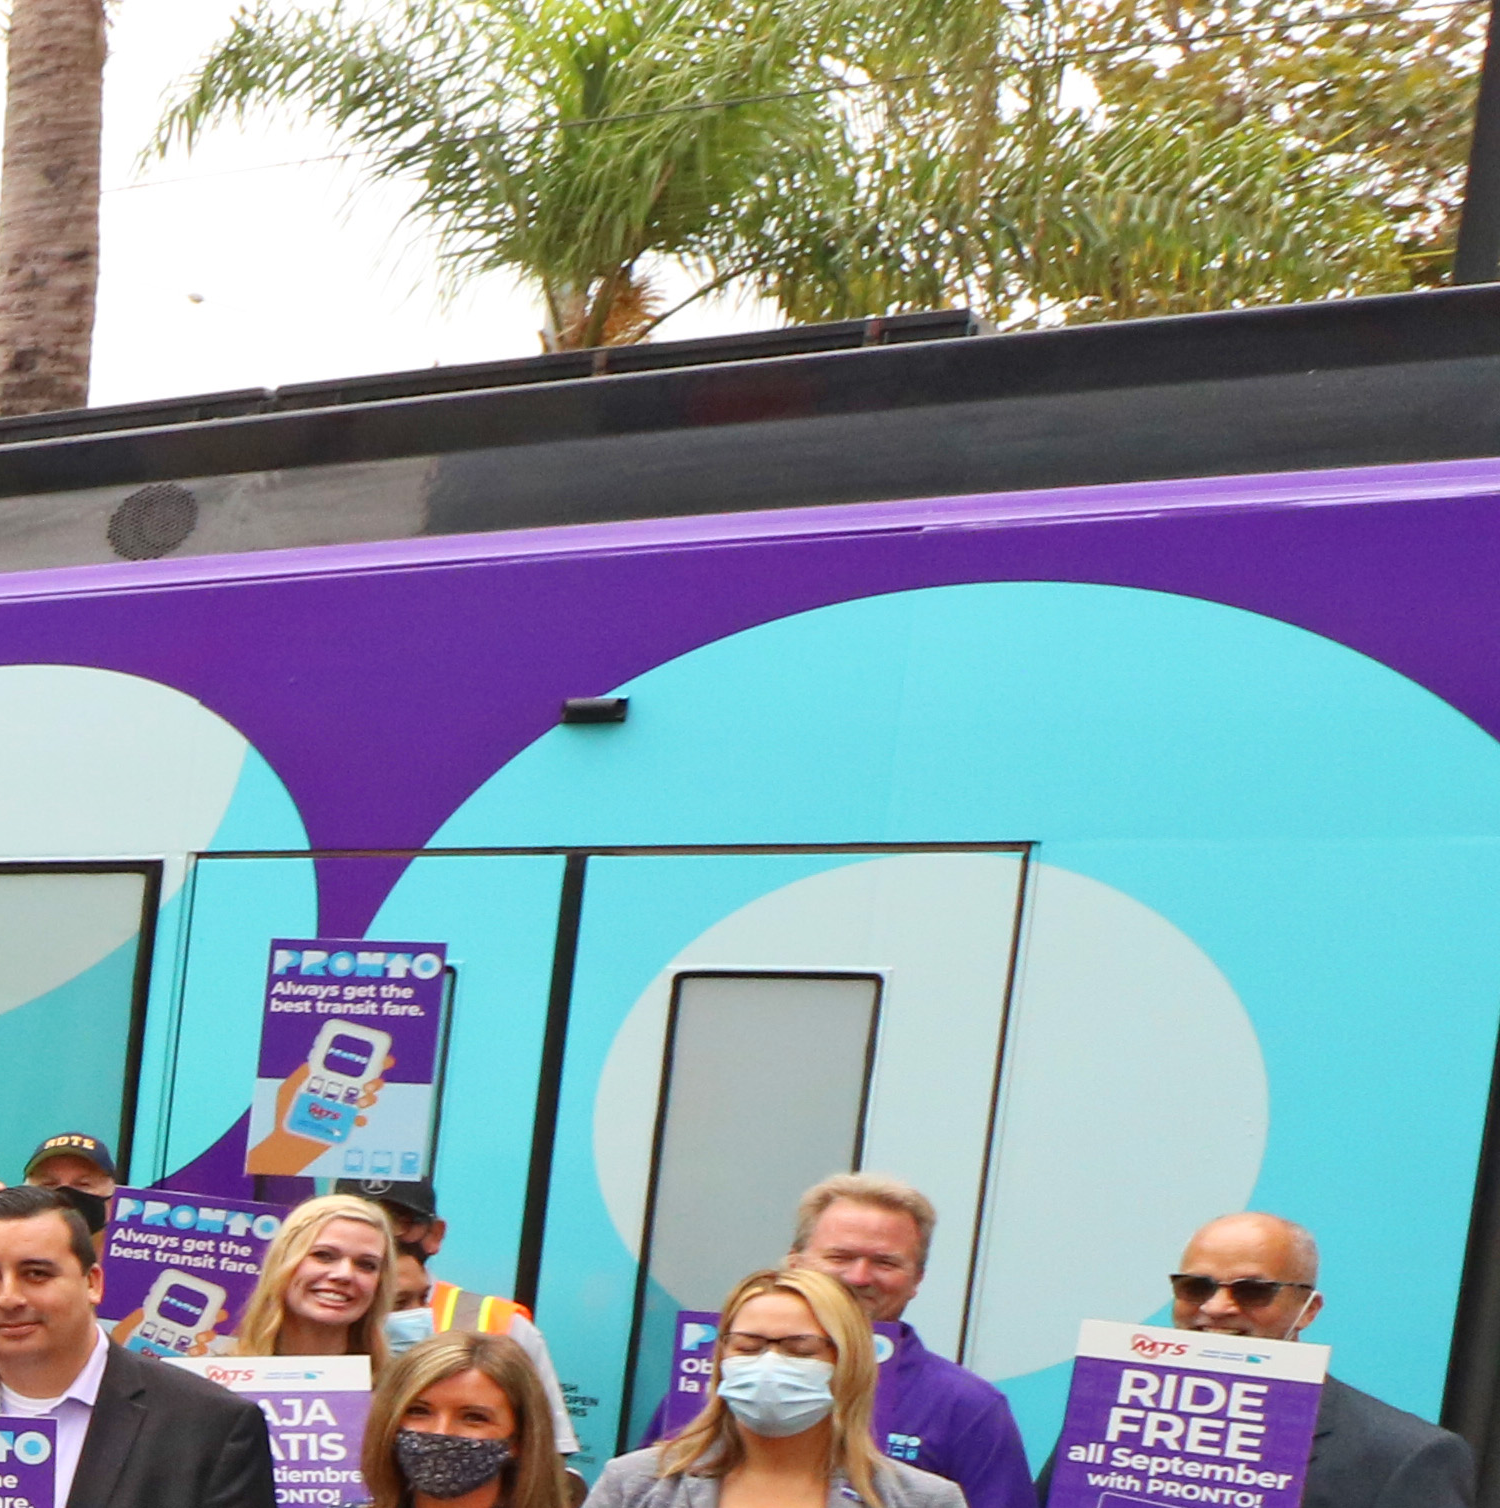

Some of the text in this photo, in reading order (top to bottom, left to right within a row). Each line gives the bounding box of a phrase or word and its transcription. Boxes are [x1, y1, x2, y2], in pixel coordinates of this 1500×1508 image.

[273, 949, 442, 980] PRONTO
[271, 981, 414, 1000] Always get the
[270, 998, 425, 1017] best transit fare.
[115, 1198, 283, 1240] PRONTO
[112, 1228, 252, 1257] Always get the
[109, 1244, 263, 1275] best transit fare.
[1117, 1368, 1268, 1421] RIDE
[1105, 1406, 1266, 1462] FREE
[1067, 1443, 1292, 1490] all September
[1087, 1471, 1142, 1493] with
